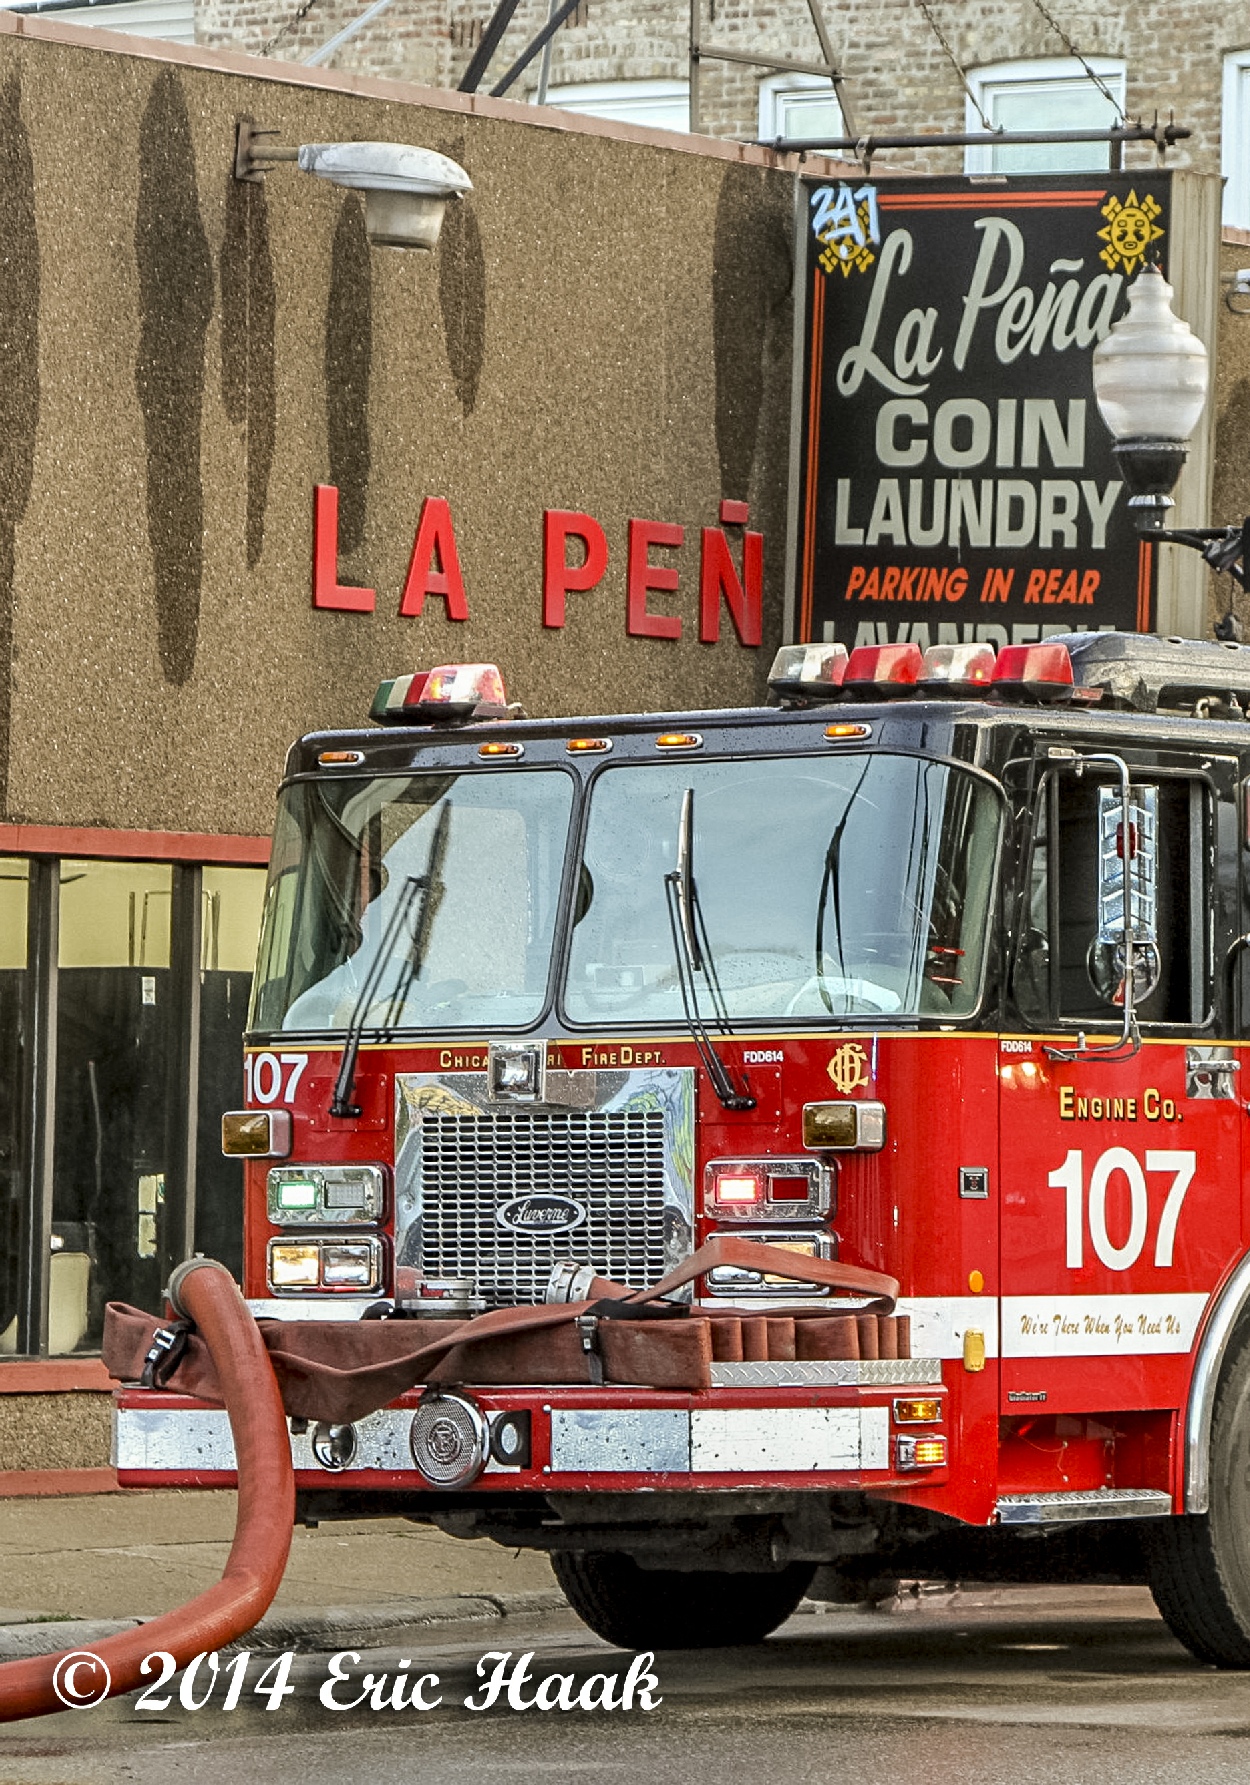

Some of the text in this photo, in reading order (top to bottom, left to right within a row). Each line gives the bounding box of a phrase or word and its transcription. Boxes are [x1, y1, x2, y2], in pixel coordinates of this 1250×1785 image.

[837, 216, 1124, 397] La Peña
[875, 397, 1087, 469] COIN
[835, 477, 1123, 550] LAUNDRY
[313, 484, 765, 647] LA PEÑ
[845, 565, 1101, 604] PARKING IN REAR
[440, 1050, 490, 1068] CHICA
[582, 1047, 617, 1066] FIRE
[743, 1050, 784, 1063] FDD614
[1000, 1040, 1032, 1053] FDD614
[244, 1052, 309, 1104] 107
[1060, 1085, 1137, 1121] ENGINE
[512, 1200, 569, 1224] Luverne
[1048, 1146, 1197, 1272] 107
[1020, 1313, 1181, 1344] We're There When You Need Us
